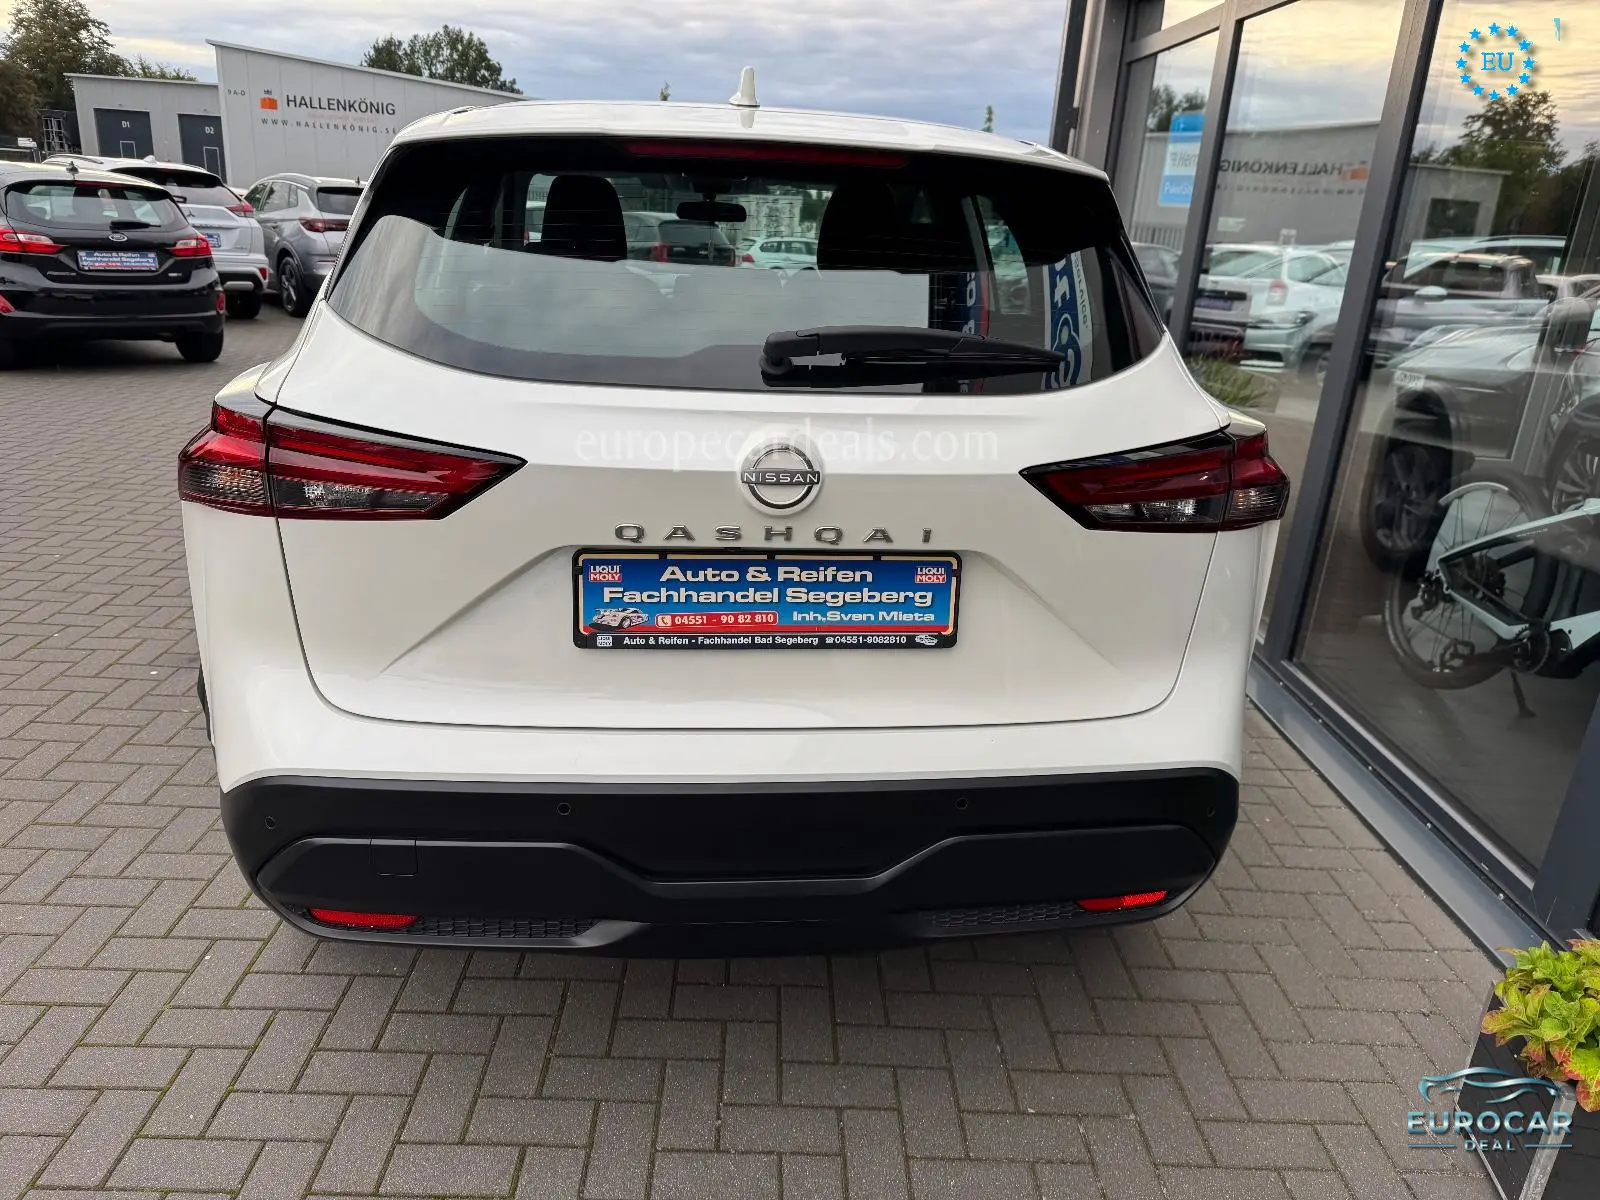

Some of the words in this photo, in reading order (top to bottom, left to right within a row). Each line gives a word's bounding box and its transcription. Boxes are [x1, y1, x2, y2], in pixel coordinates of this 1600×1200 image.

[286, 94, 396, 116] HALLENKÖNIG
[122, 120, 131, 128] D1
[204, 126, 215, 134] D2
[744, 472, 819, 484] NISSAN
[614, 522, 933, 545] QASHQAI
[589, 565, 621, 574] LIQUI
[659, 566, 740, 582] Auto
[745, 566, 772, 582] &
[777, 566, 873, 583] Reifen
[916, 567, 945, 575] LIQUI
[589, 573, 622, 582] MOLY
[915, 575, 946, 583] MOLY
[603, 587, 779, 603] Fachhandel
[785, 587, 933, 607] Segeberg
[674, 615, 708, 625] 04551
[720, 614, 735, 624] 90
[737, 614, 752, 624] 82
[754, 613, 774, 623] 810
[623, 636, 646, 645] Auto
[648, 636, 656, 645] &
[658, 636, 689, 645] Reifen
[697, 636, 752, 644] Fachhandel
[754, 636, 773, 644] Bad
[774, 636, 819, 646] Segeberg
[834, 636, 907, 644] 04551-9082810
